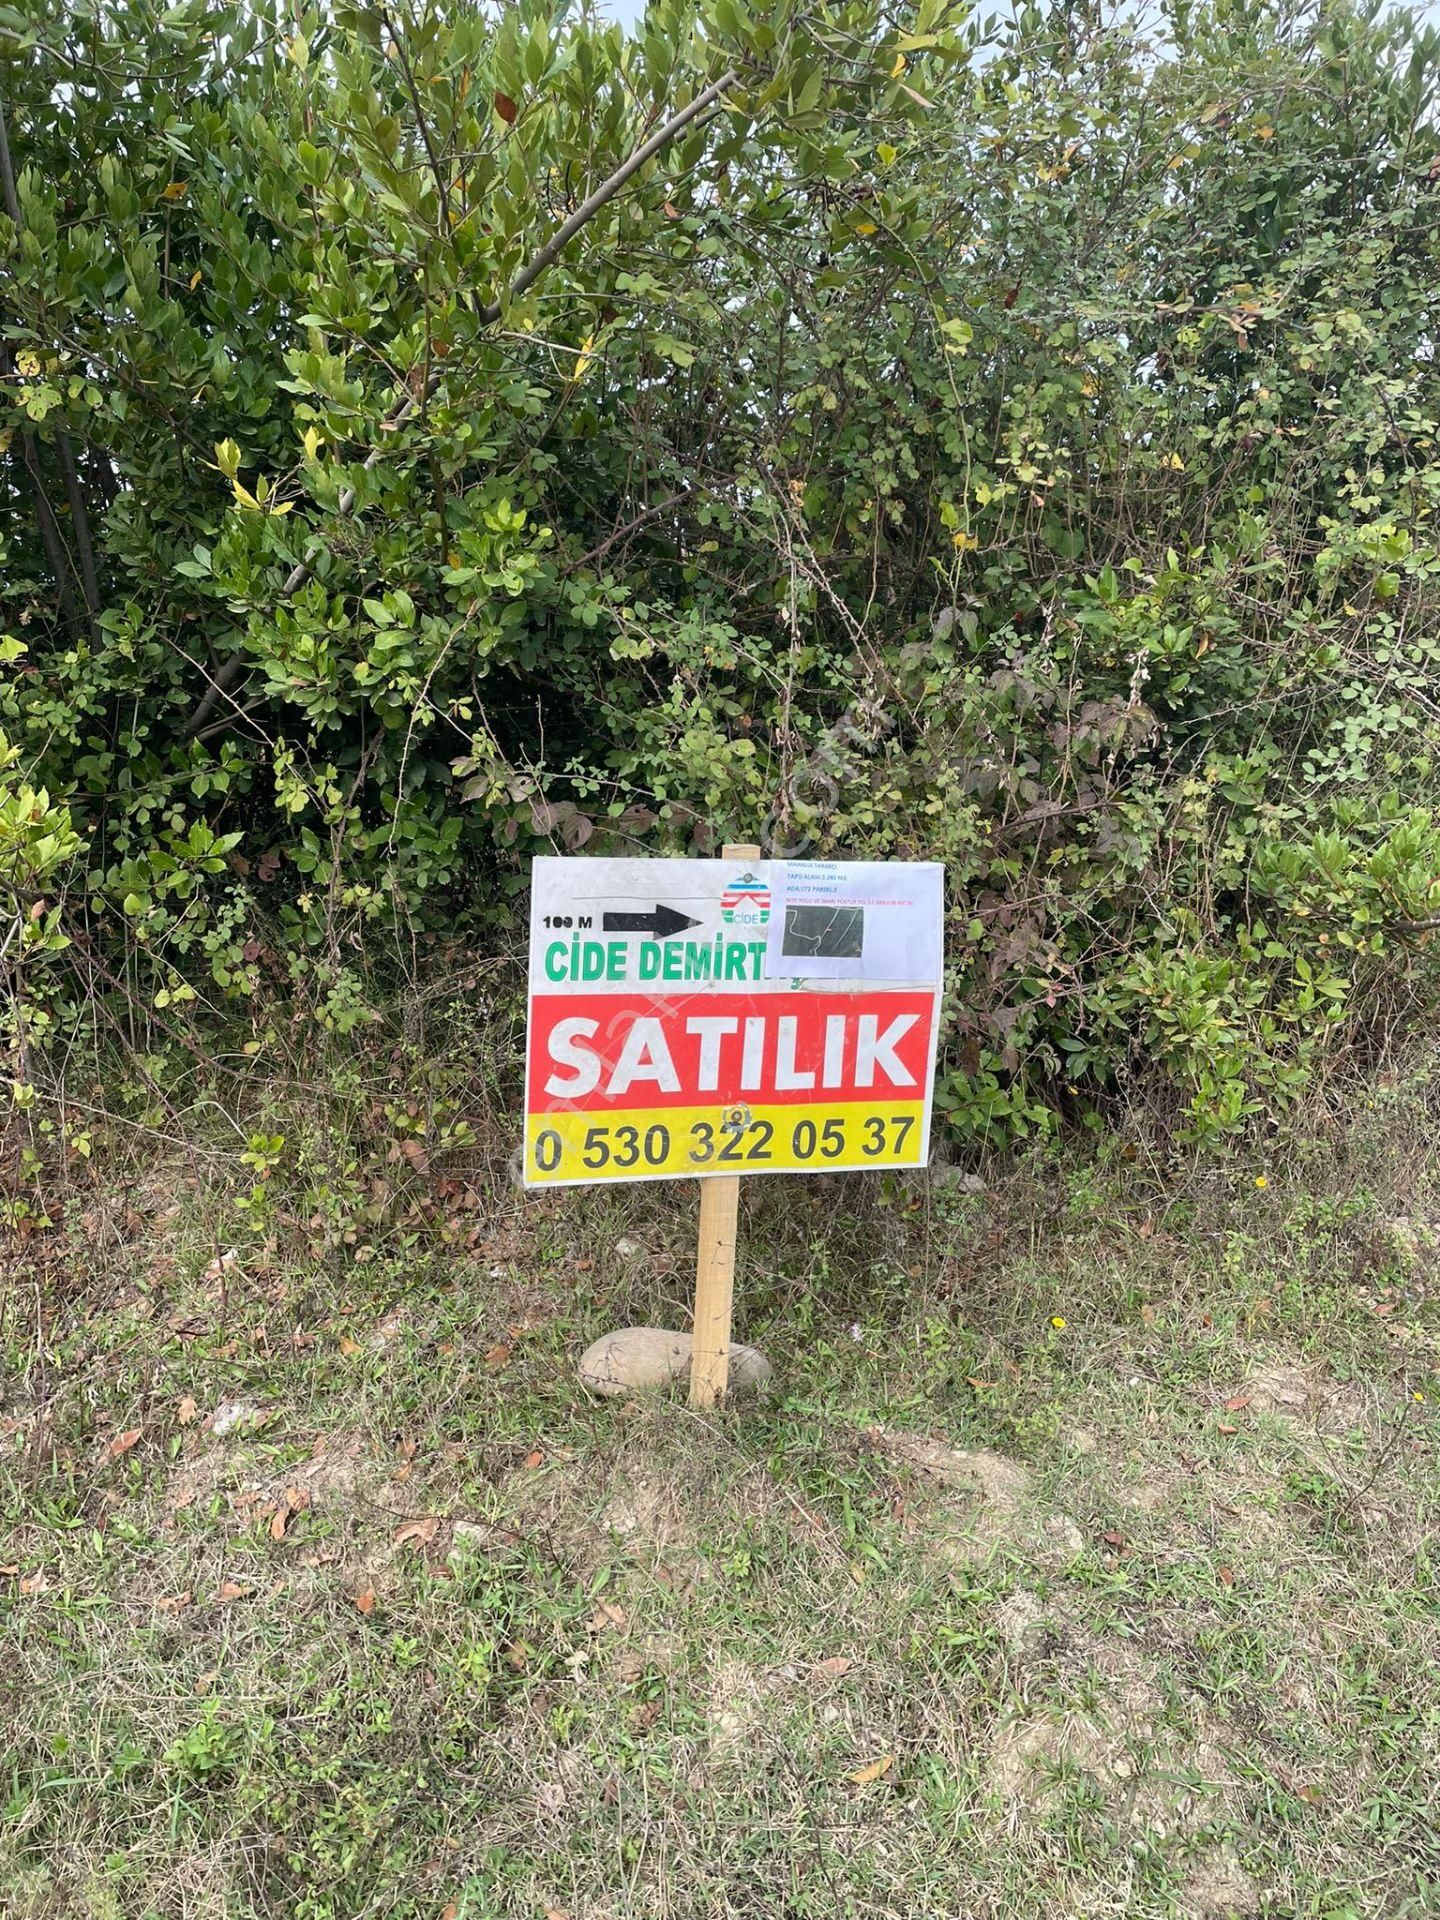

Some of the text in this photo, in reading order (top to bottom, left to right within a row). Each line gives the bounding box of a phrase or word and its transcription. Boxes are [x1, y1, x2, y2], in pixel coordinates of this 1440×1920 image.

[578, 916, 593, 928] M
[733, 911, 760, 925] CİDE
[545, 932, 801, 989] CİDE DEMİRT
[543, 1014, 922, 1099] SATILIK
[535, 1116, 916, 1171] 0 530 322 05 37
